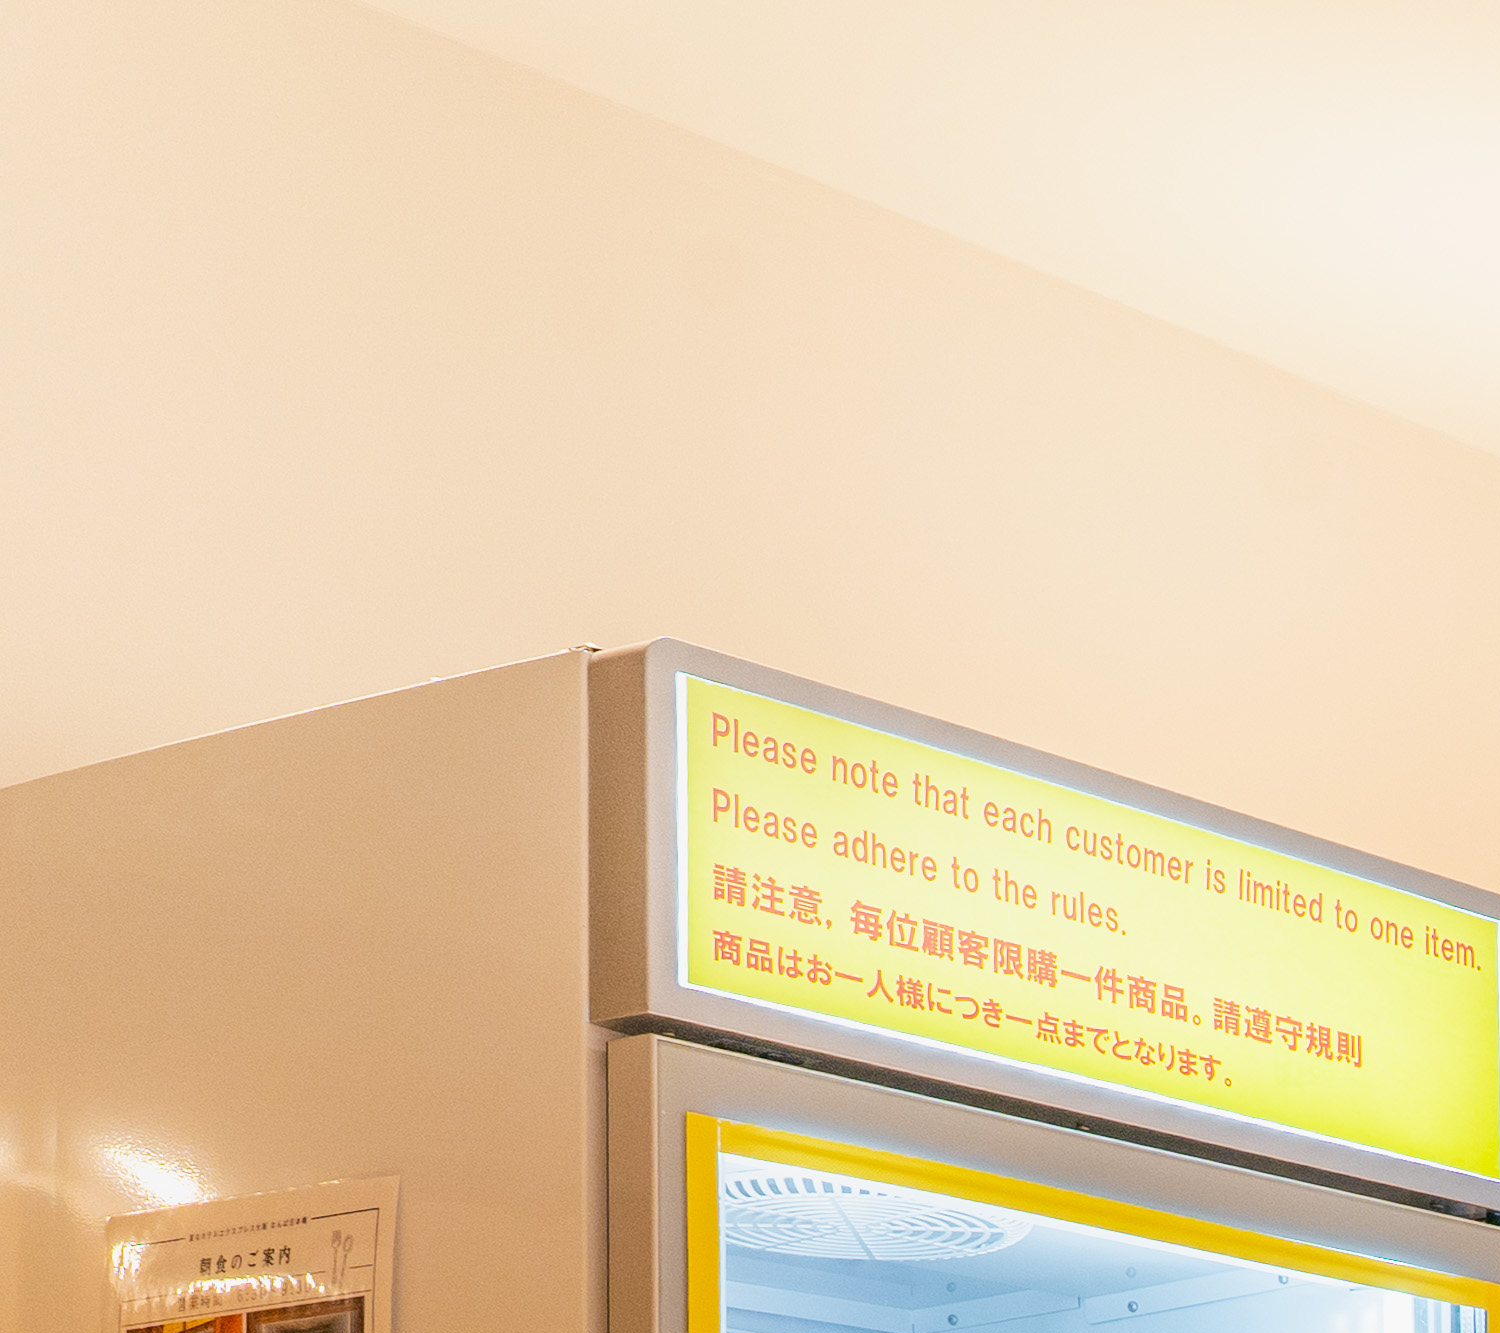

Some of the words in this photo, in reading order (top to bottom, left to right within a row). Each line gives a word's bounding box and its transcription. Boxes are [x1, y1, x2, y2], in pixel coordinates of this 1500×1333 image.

[713, 712, 816, 773] Please
[832, 756, 897, 797] note
[913, 773, 968, 818] that
[984, 802, 1051, 843] each
[1066, 827, 1193, 883] customer
[1207, 859, 1225, 893] is
[1240, 869, 1322, 922] limited
[1335, 900, 1357, 932] to
[1371, 917, 1413, 948] one
[1426, 926, 1480, 970] item.
[713, 788, 816, 847] Please
[834, 831, 936, 880] adhere
[952, 857, 978, 892] to
[993, 869, 1036, 908] the
[1052, 892, 1125, 934] rules.
